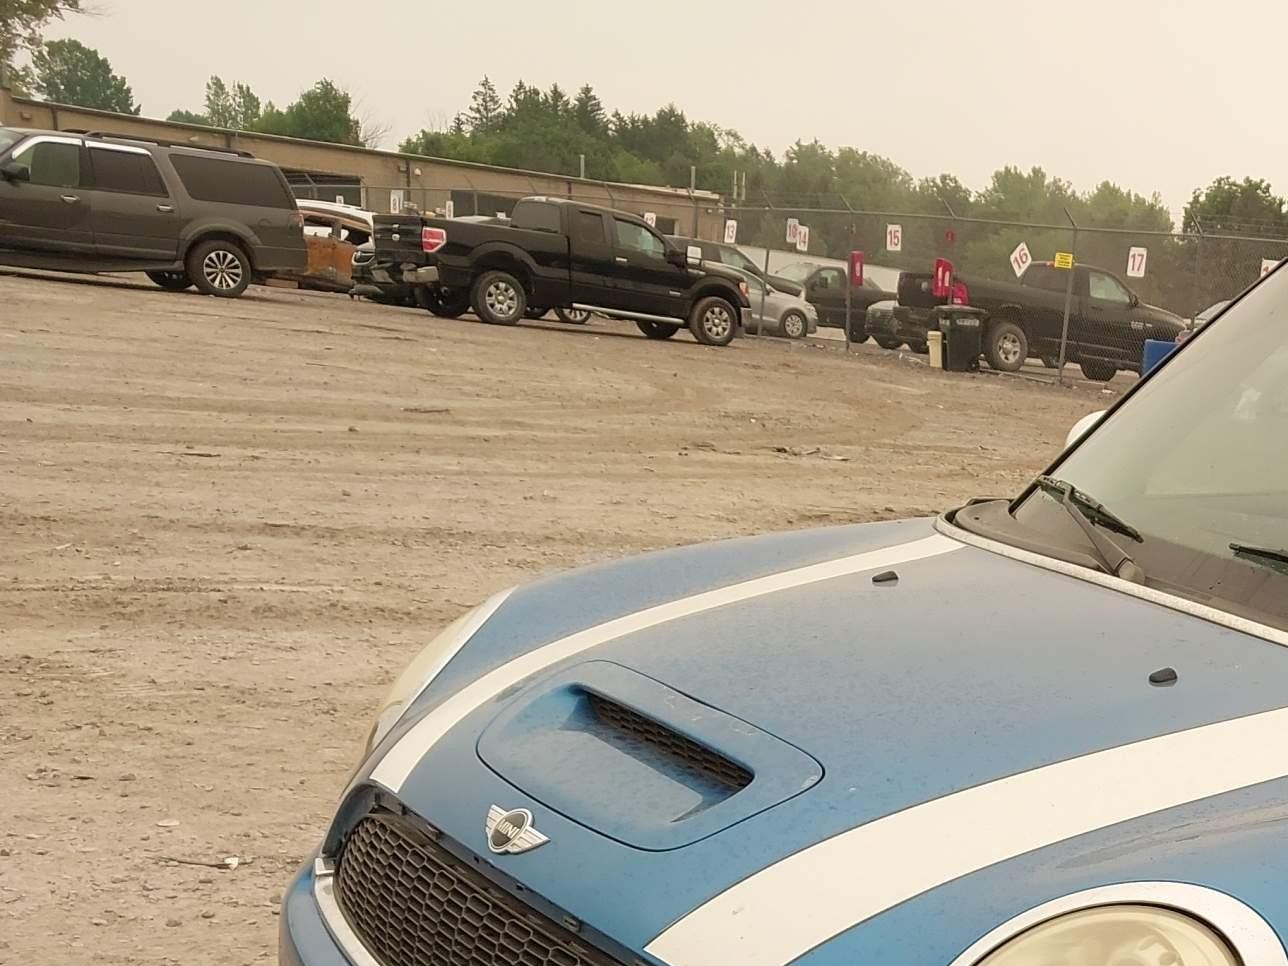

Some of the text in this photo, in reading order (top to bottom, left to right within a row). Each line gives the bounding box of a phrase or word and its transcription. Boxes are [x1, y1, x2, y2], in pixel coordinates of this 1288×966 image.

[726, 223, 735, 239] 13
[798, 230, 807, 246] 14
[888, 229, 900, 247] 15
[1012, 247, 1029, 270] 16
[1130, 253, 1145, 273] 17
[497, 818, 520, 839] MINI
